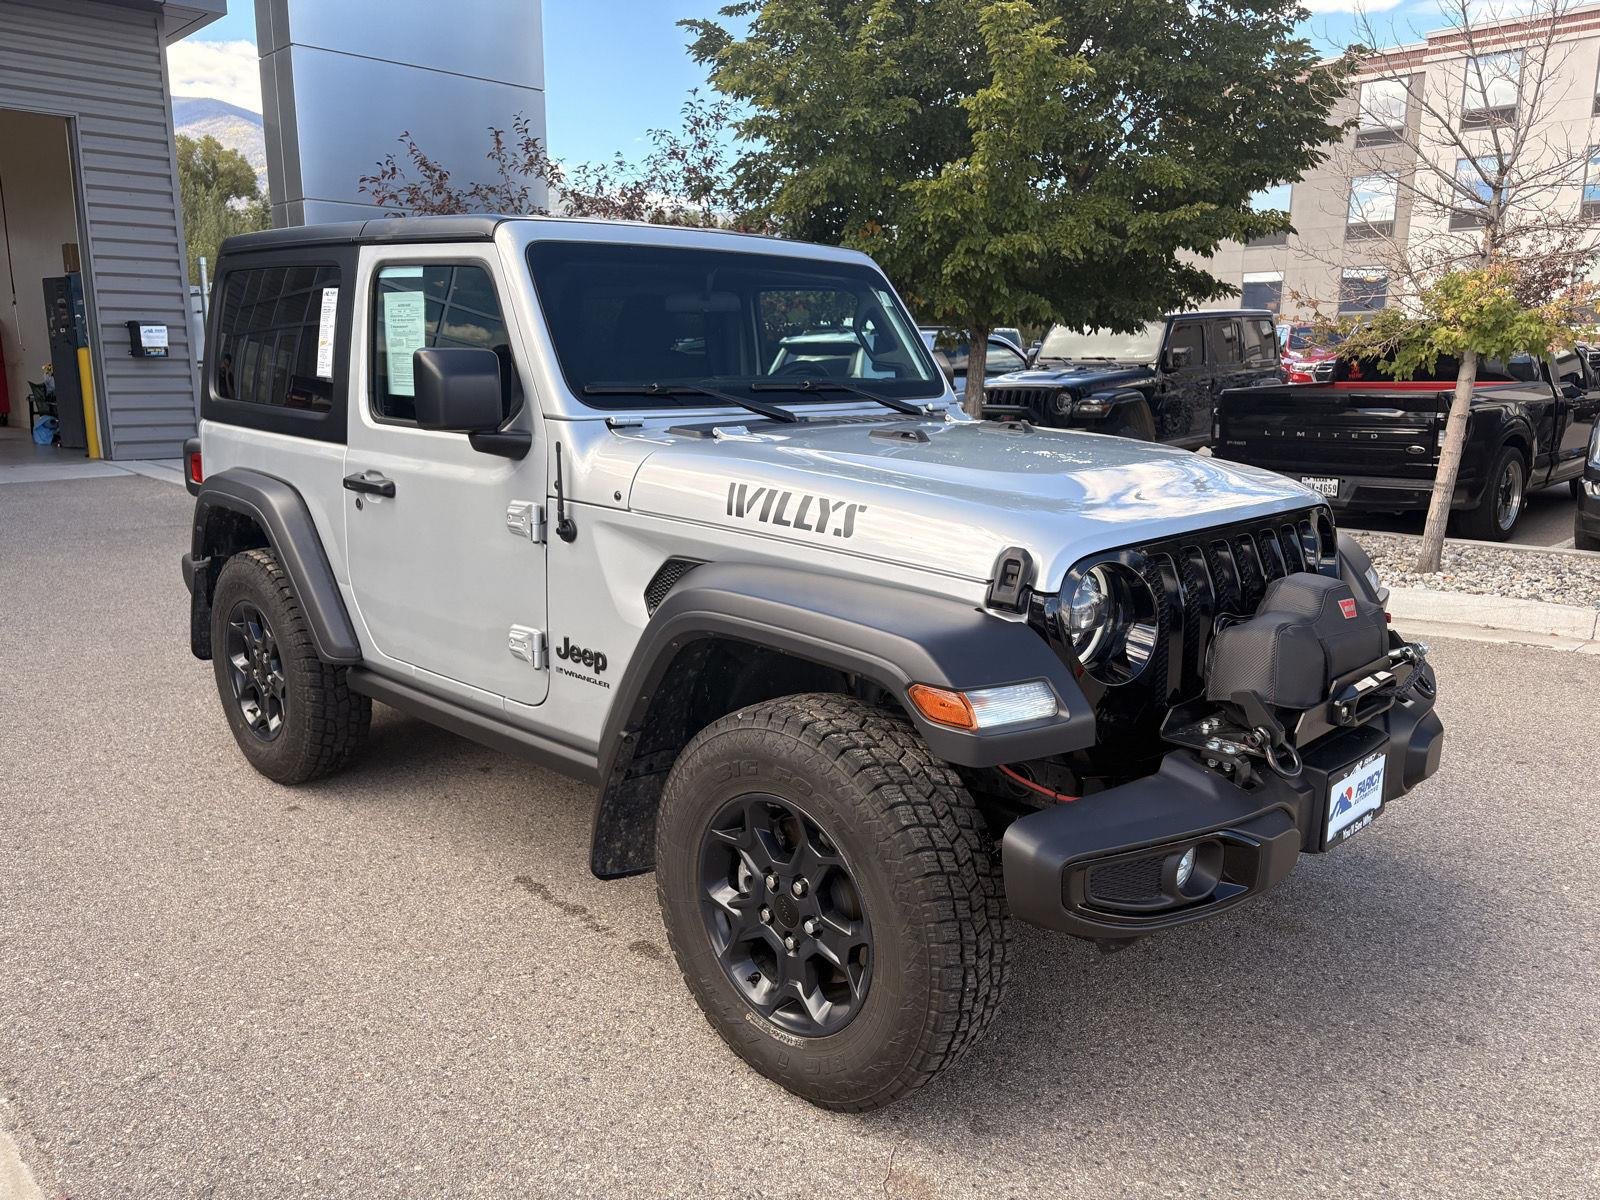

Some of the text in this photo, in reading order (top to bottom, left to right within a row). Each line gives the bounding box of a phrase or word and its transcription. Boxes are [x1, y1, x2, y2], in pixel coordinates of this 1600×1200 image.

[1264, 430, 1378, 439] LIMITED
[726, 482, 868, 538] WILLYS
[556, 636, 607, 675] Jeep
[563, 668, 610, 689] WRANGLER
[1355, 767, 1383, 798] FARICY
